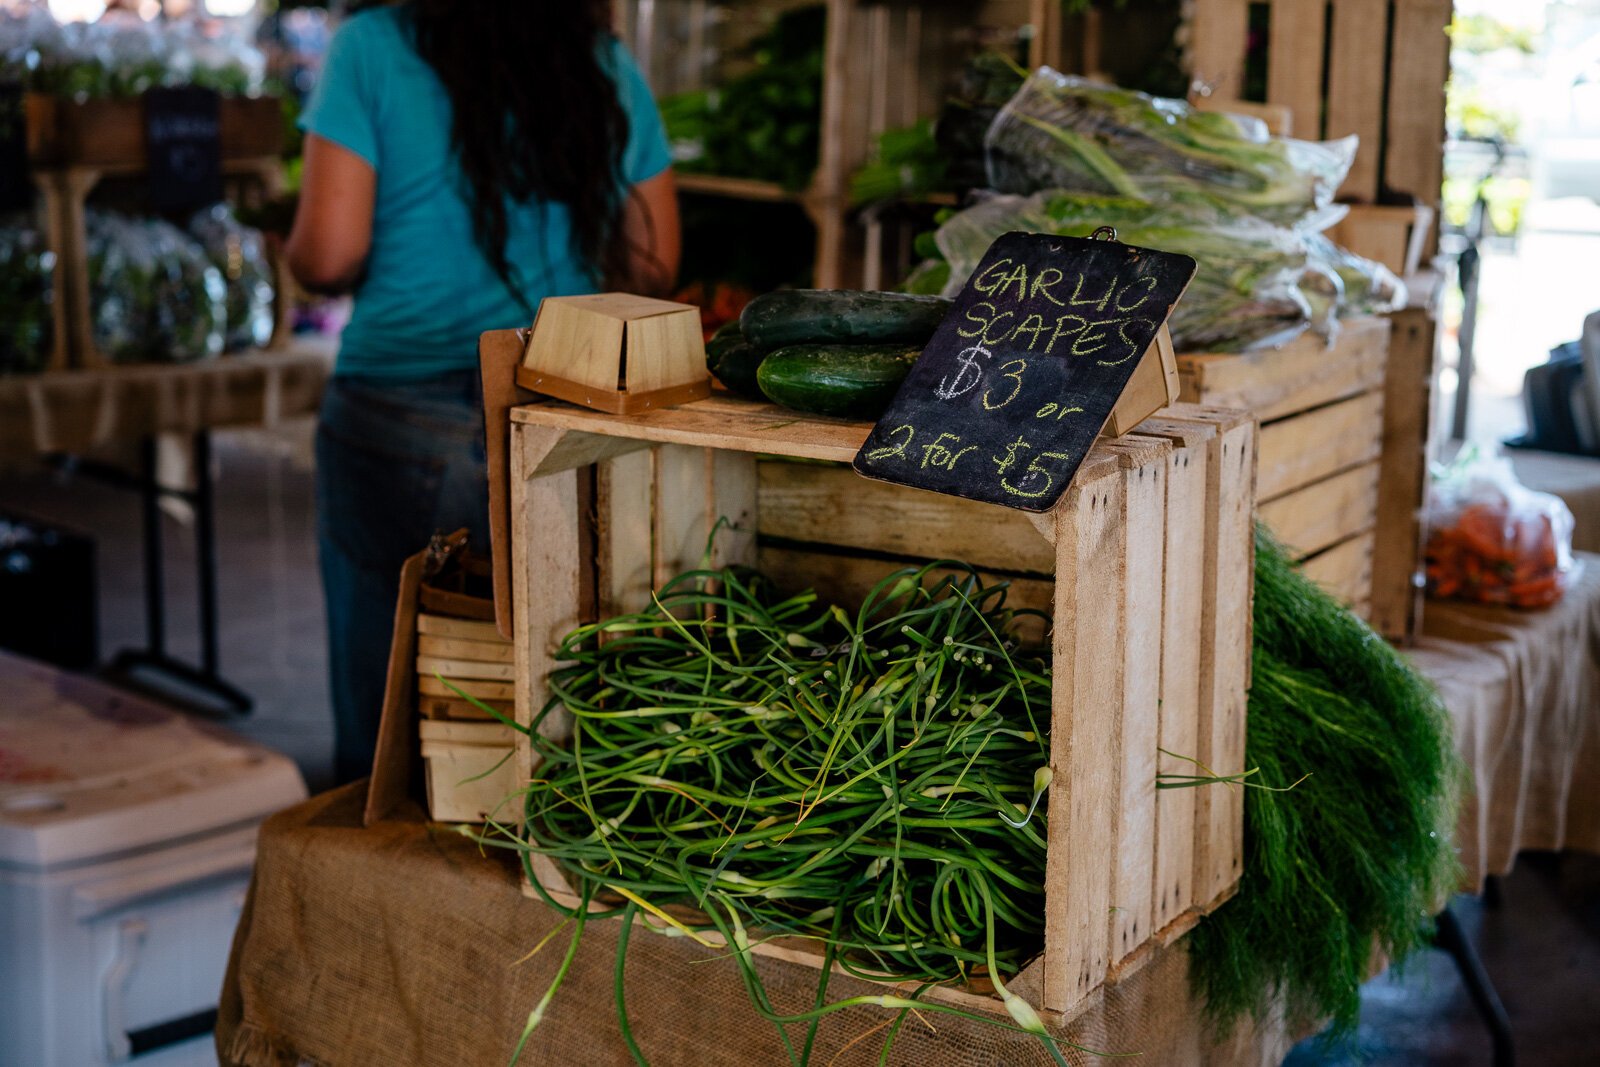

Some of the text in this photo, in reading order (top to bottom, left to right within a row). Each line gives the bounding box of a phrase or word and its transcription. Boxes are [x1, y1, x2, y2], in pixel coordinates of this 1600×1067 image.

[973, 258, 1157, 313] GARLIC
[957, 302, 1157, 366] SCAPES
[1036, 403, 1084, 421] or
[867, 424, 914, 461] 2
[993, 436, 1069, 497] $5
